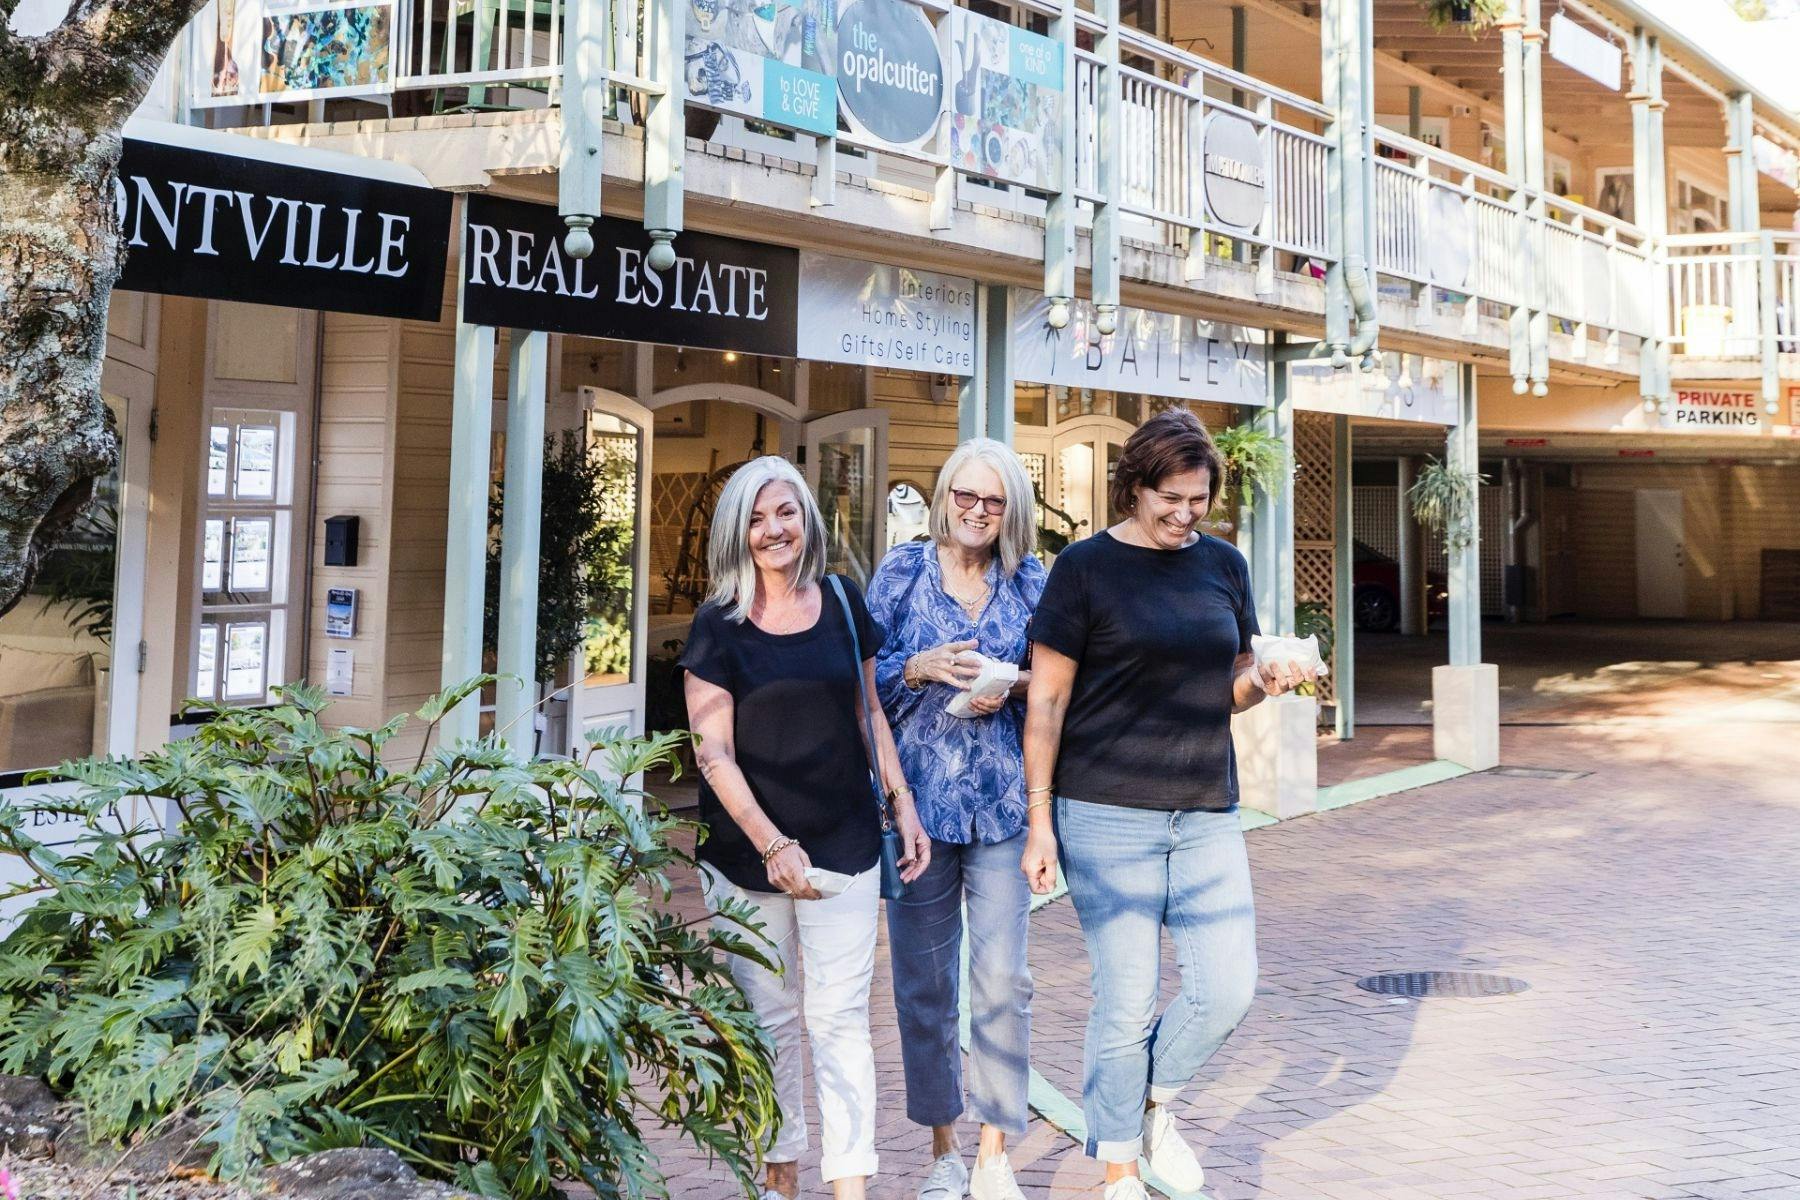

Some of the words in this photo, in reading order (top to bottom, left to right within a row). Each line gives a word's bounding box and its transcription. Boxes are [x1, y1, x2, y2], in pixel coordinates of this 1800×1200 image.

[852, 21, 878, 53] the
[843, 47, 938, 97] opalcutter
[1025, 56, 1046, 75] KIND
[780, 75, 790, 93] to
[793, 76, 821, 101] LOVE
[782, 93, 791, 112] &
[793, 96, 819, 120] GIVE
[468, 223, 599, 300] REAL
[615, 246, 769, 322] ESTATE
[902, 282, 971, 307] Interiors
[862, 304, 907, 328] Home
[916, 311, 970, 341] Styling
[841, 333, 927, 360] Gifts/Self
[934, 345, 970, 367] Care
[1086, 320, 1249, 389] BAILEY
[1677, 391, 1755, 408] PRIVATE
[1676, 410, 1758, 426] PARKING
